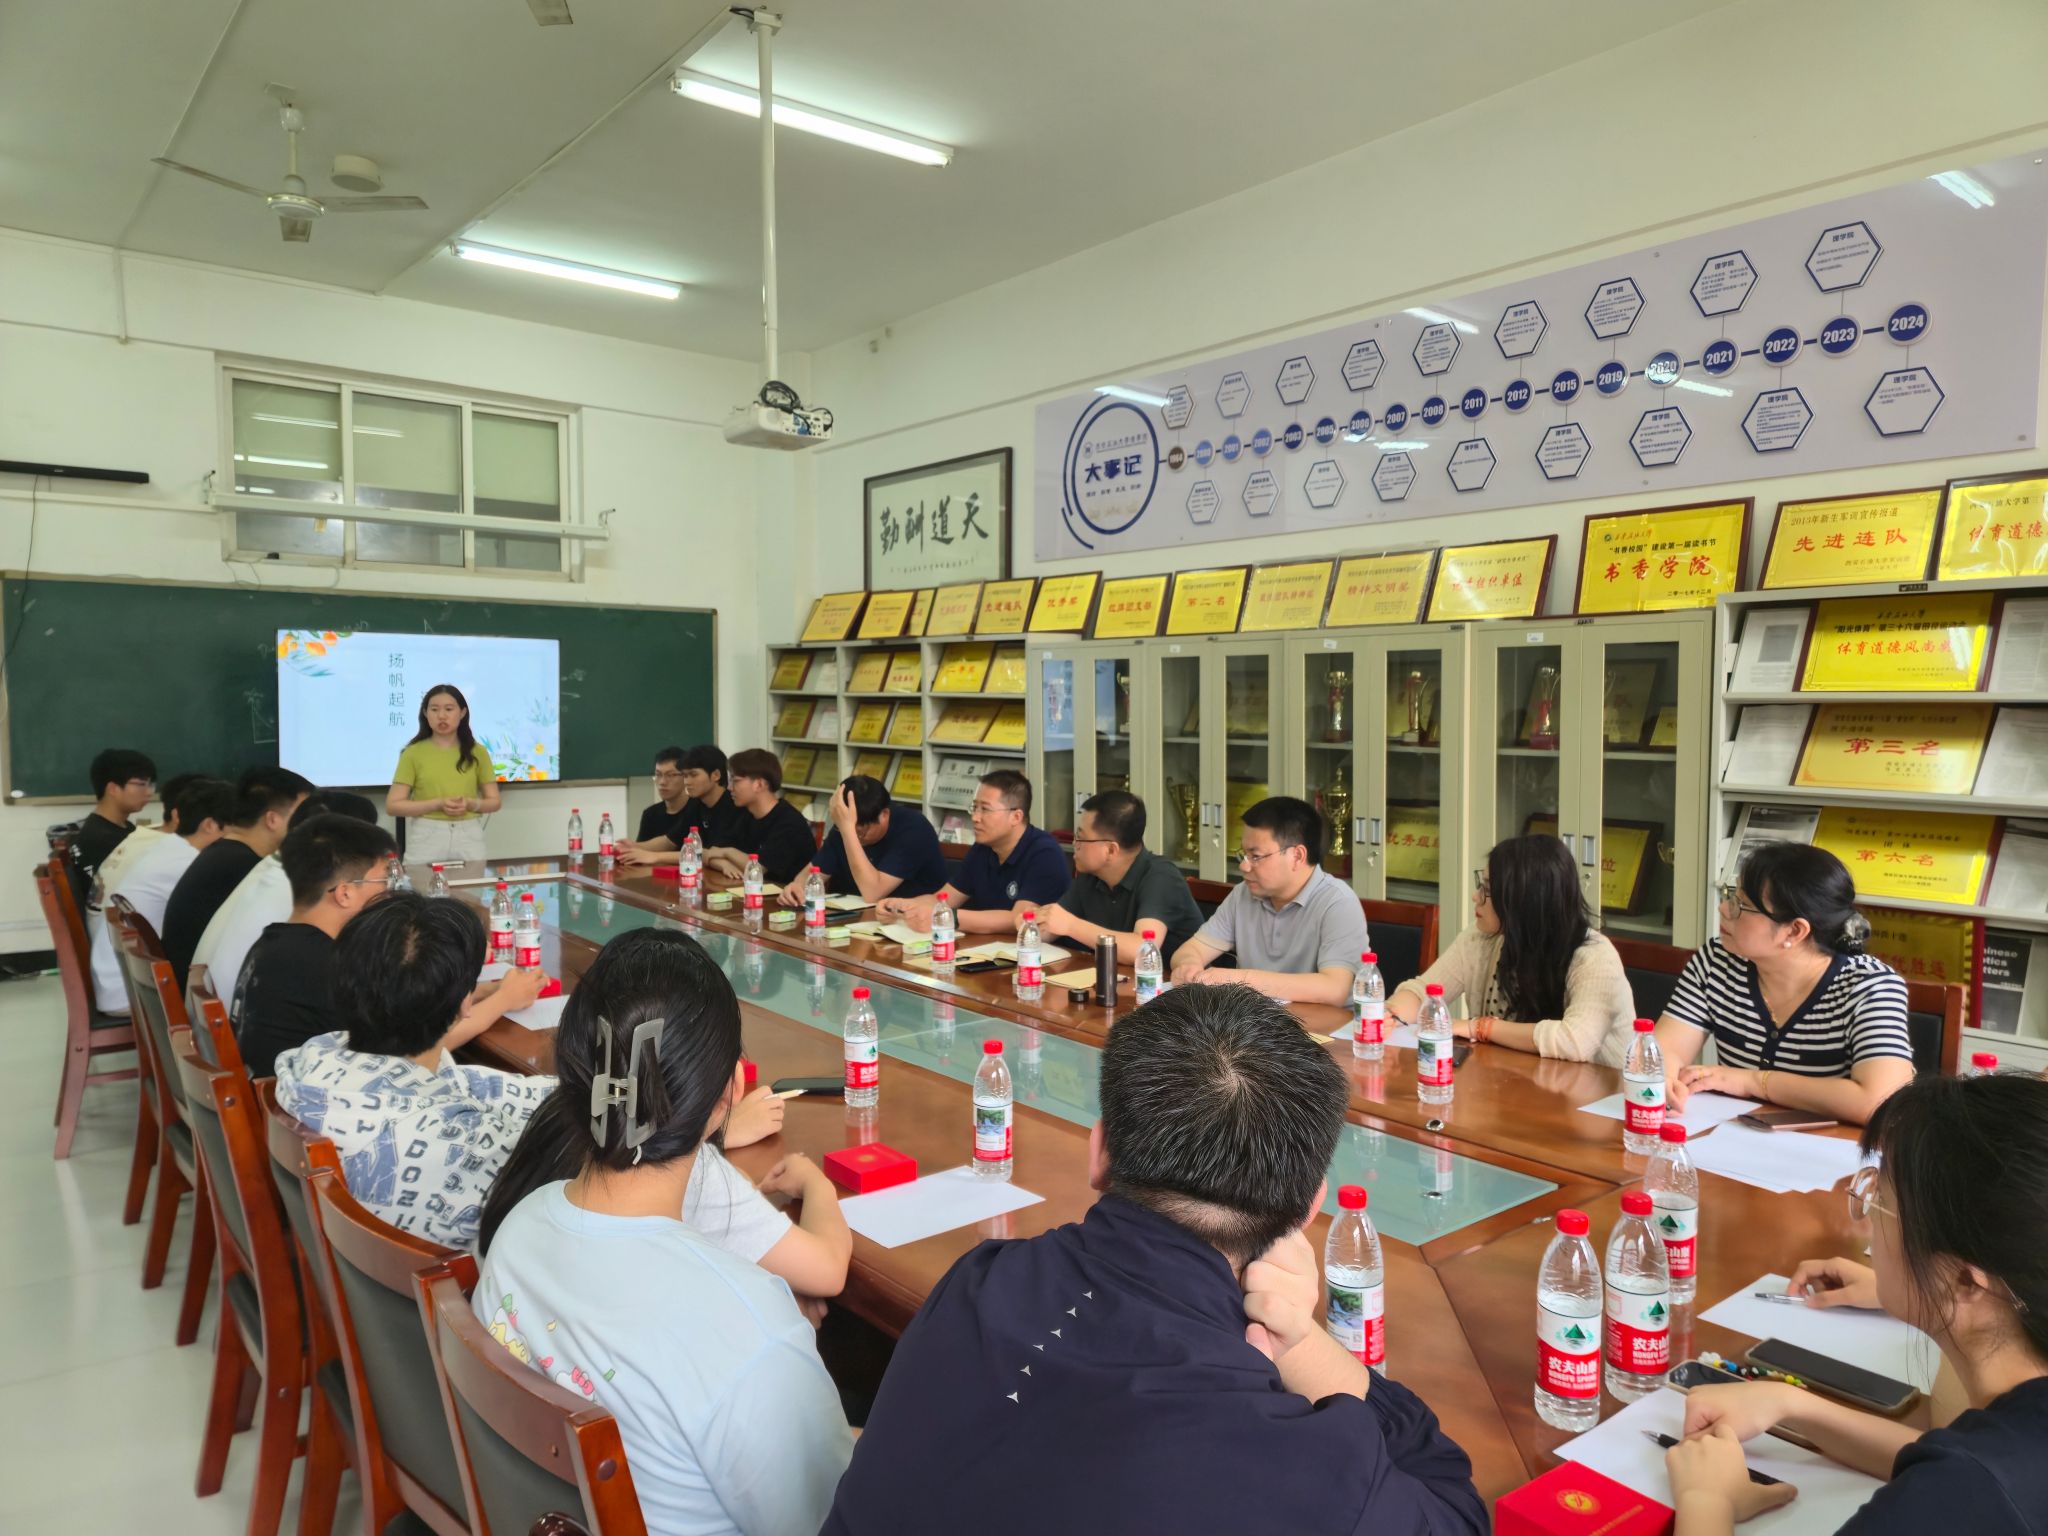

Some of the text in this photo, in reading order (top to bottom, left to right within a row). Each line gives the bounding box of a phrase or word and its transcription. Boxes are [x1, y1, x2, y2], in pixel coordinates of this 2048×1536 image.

[1832, 231, 1854, 243] 理学院
[1890, 313, 1924, 332] 2024
[1823, 327, 1855, 345] 2023
[1765, 338, 1796, 354] 2022
[1706, 351, 1733, 367] 2021
[1650, 361, 1677, 376] 2020
[1598, 371, 1623, 386] 2019
[1892, 374, 1917, 385] 理学院
[1554, 380, 1577, 393] 2015
[1507, 388, 1528, 402] 2012
[1464, 398, 1483, 410] 2011
[1386, 411, 1405, 425] 2007
[1423, 406, 1444, 418] 2008
[1085, 454, 1142, 484] 大事记
[1793, 528, 1908, 552] 先进连队
[1604, 555, 1713, 582] 书香学院
[1187, 596, 1225, 607] 第二名
[388, 653, 405, 727] 扬帆起航
[1844, 737, 1941, 756] 第三名
[1856, 849, 1934, 867] 第六名
